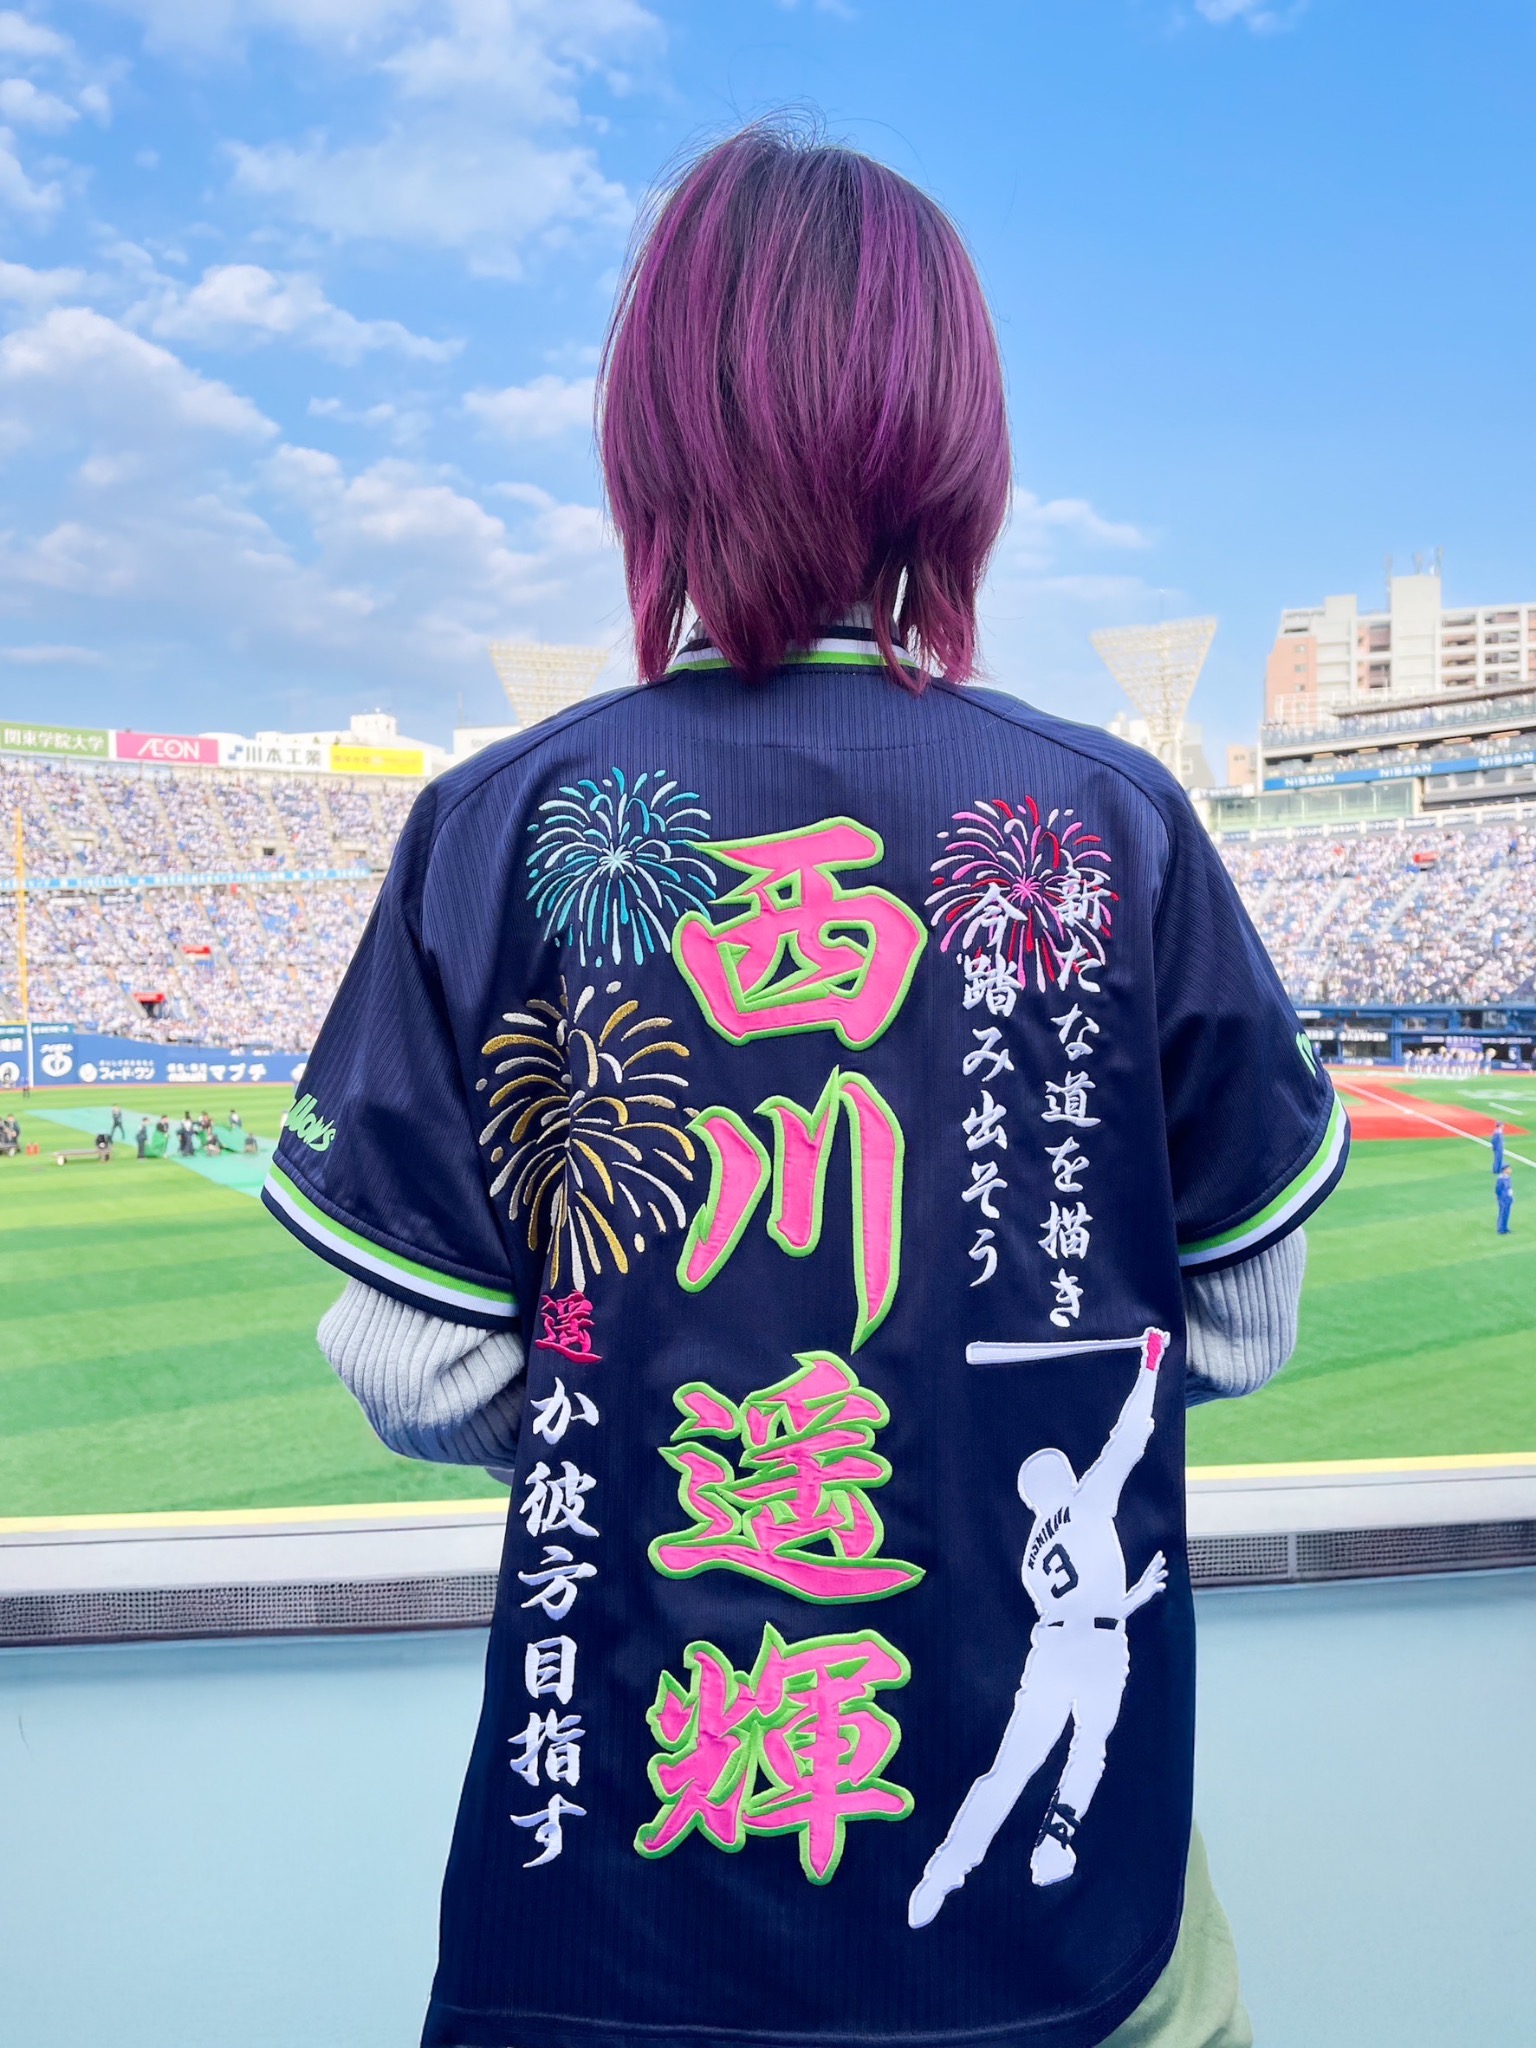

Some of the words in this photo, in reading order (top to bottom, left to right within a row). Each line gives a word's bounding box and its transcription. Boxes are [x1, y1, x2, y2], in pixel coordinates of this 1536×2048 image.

[3, 728, 105, 752] 関東学院大学
[1379, 763, 1433, 779] NISSAN
[1478, 750, 1535, 768] NISSAN
[1284, 774, 1335, 787] NISSAN
[961, 884, 1028, 1288] 今踏み出そう
[1038, 864, 1112, 1328] 新たな道を描き
[1042, 1543, 1079, 1599] 3
